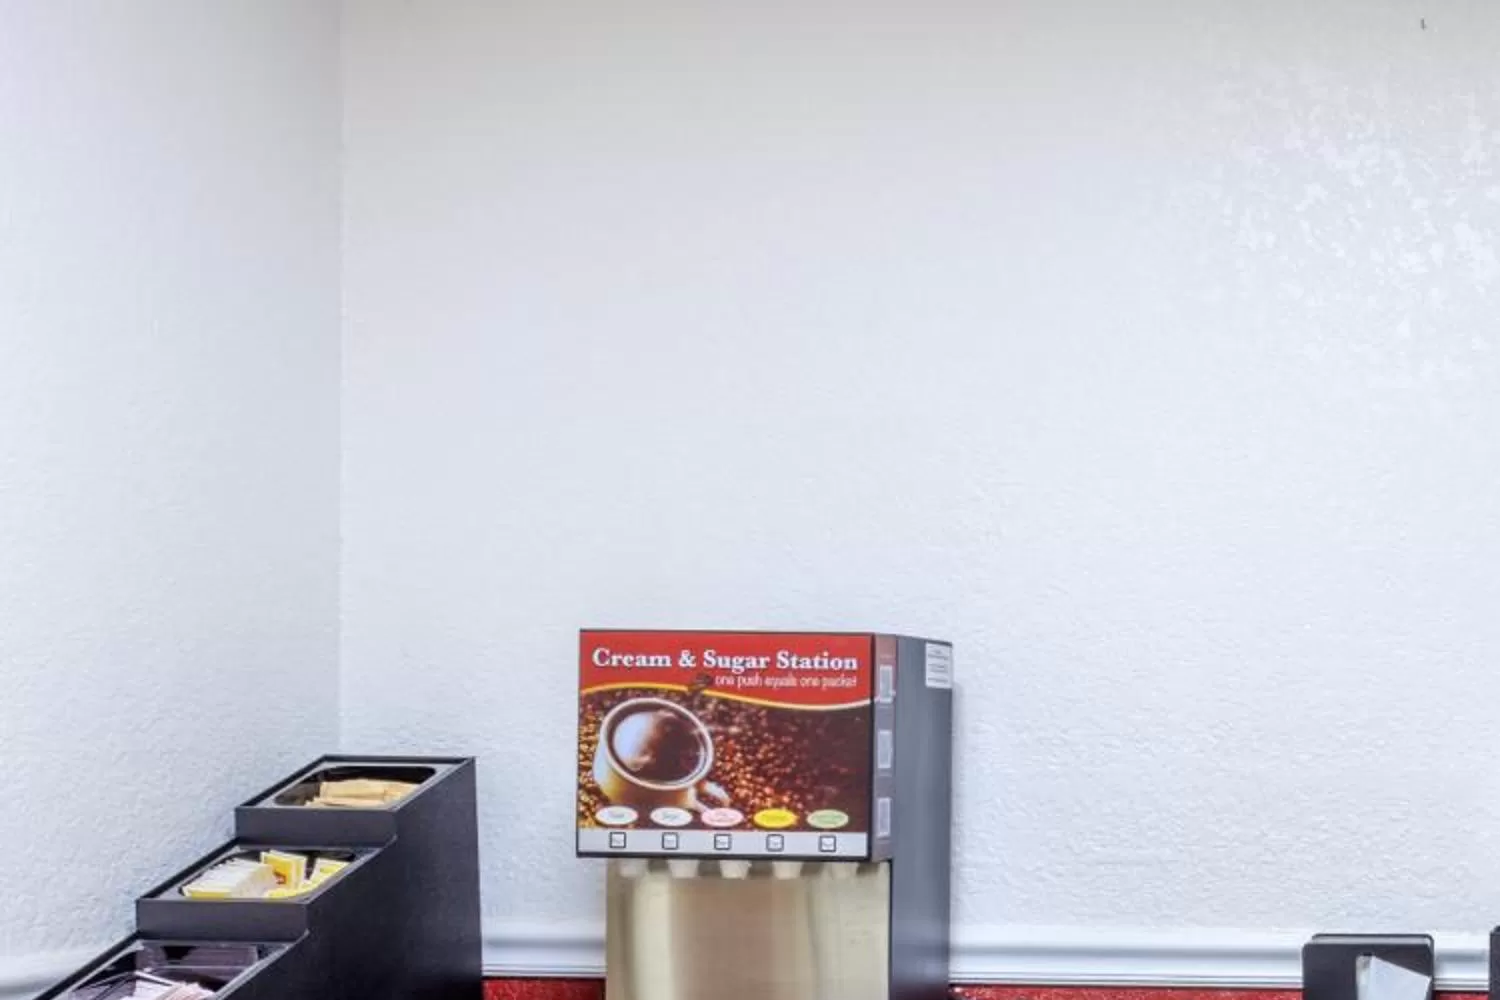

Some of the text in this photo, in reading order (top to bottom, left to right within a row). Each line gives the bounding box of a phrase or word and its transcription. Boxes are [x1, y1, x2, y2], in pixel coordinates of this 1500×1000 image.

[592, 647, 858, 673] Cream & Sugar Station
[715, 675, 735, 686] one
[737, 673, 762, 688] push
[800, 676, 821, 688] one
[822, 674, 857, 691] packet
